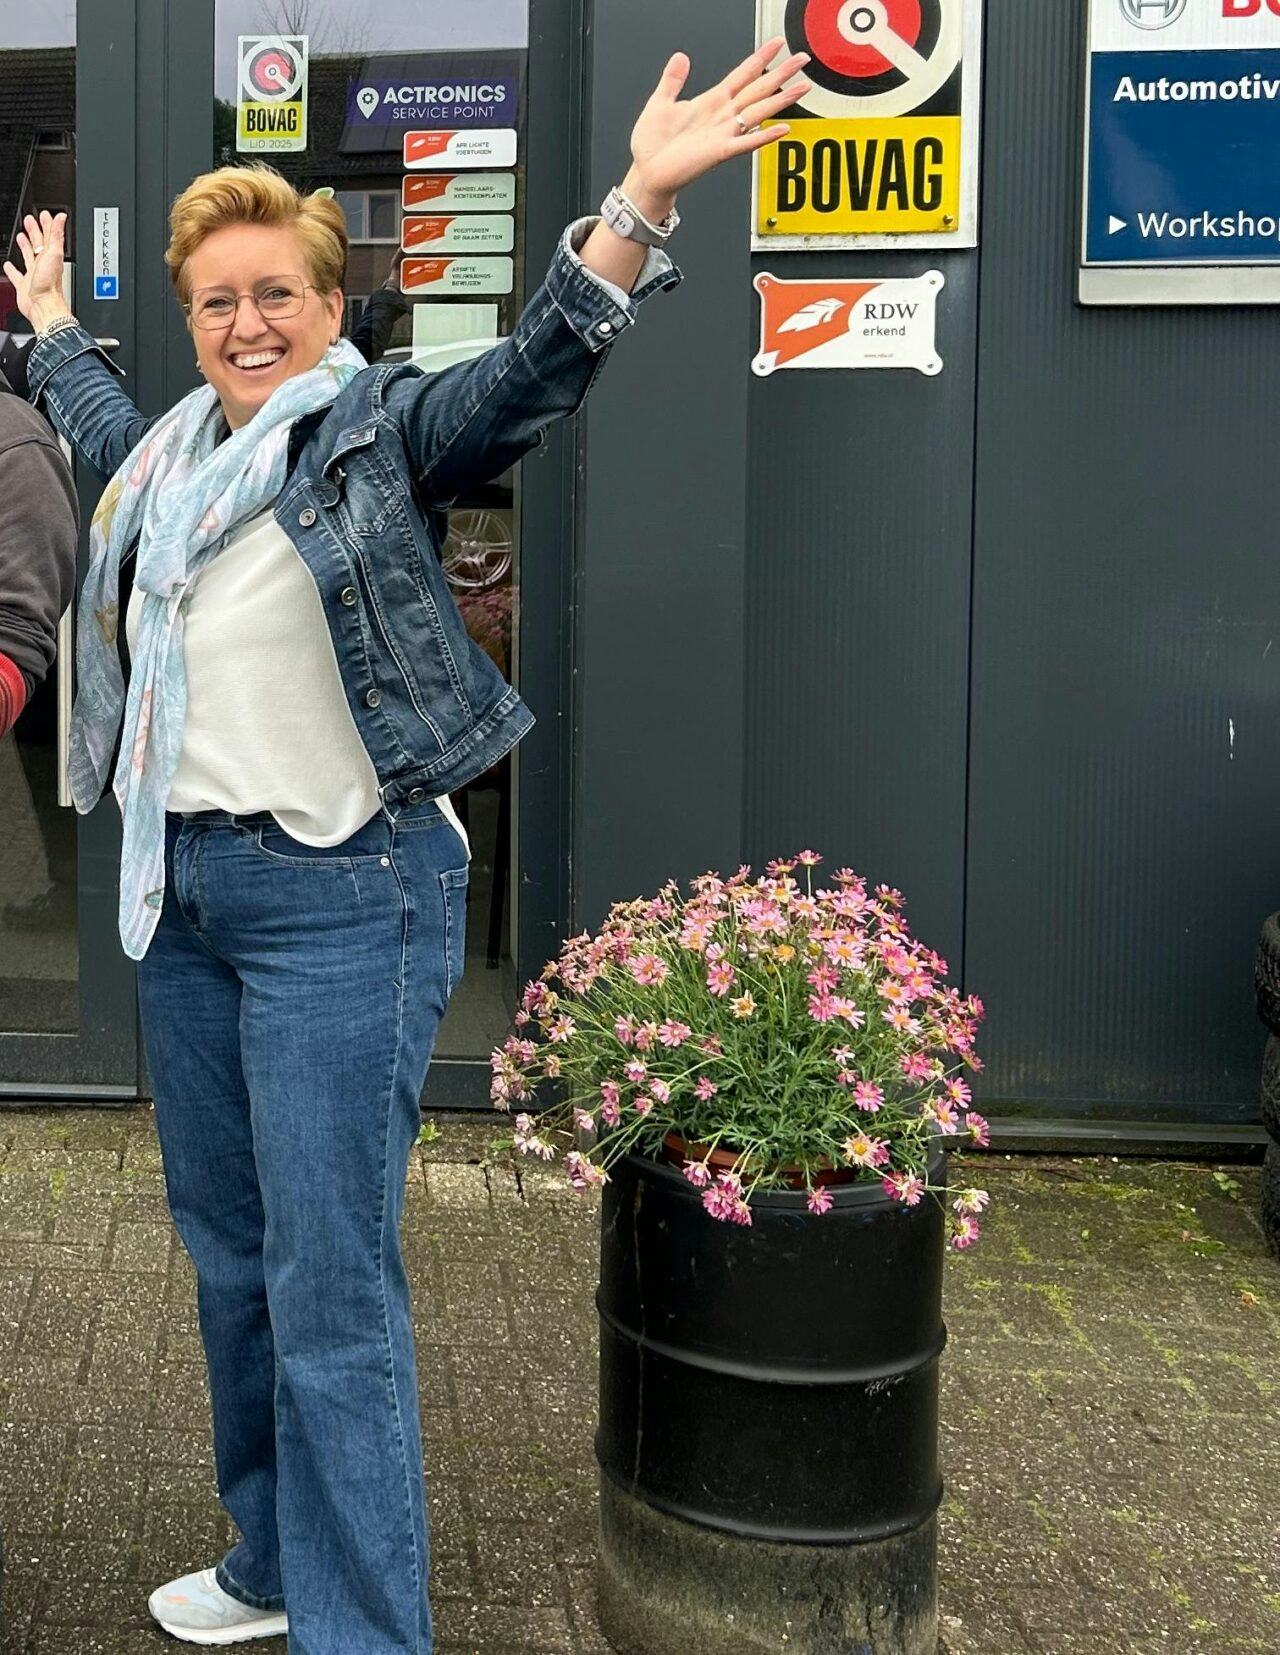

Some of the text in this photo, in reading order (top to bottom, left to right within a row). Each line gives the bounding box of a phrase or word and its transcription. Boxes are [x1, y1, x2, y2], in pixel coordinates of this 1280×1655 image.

[383, 85, 506, 104] ACTRONICS
[246, 108, 297, 132] BOVAG
[392, 106, 495, 120] SERVICE POINT
[249, 139, 293, 149] LID 2025
[776, 137, 943, 213] BOVAG
[1137, 210, 1280, 241] Worksho
[102, 212, 110, 276] trekken
[864, 303, 919, 320] RDW
[863, 325, 906, 336] erkend
